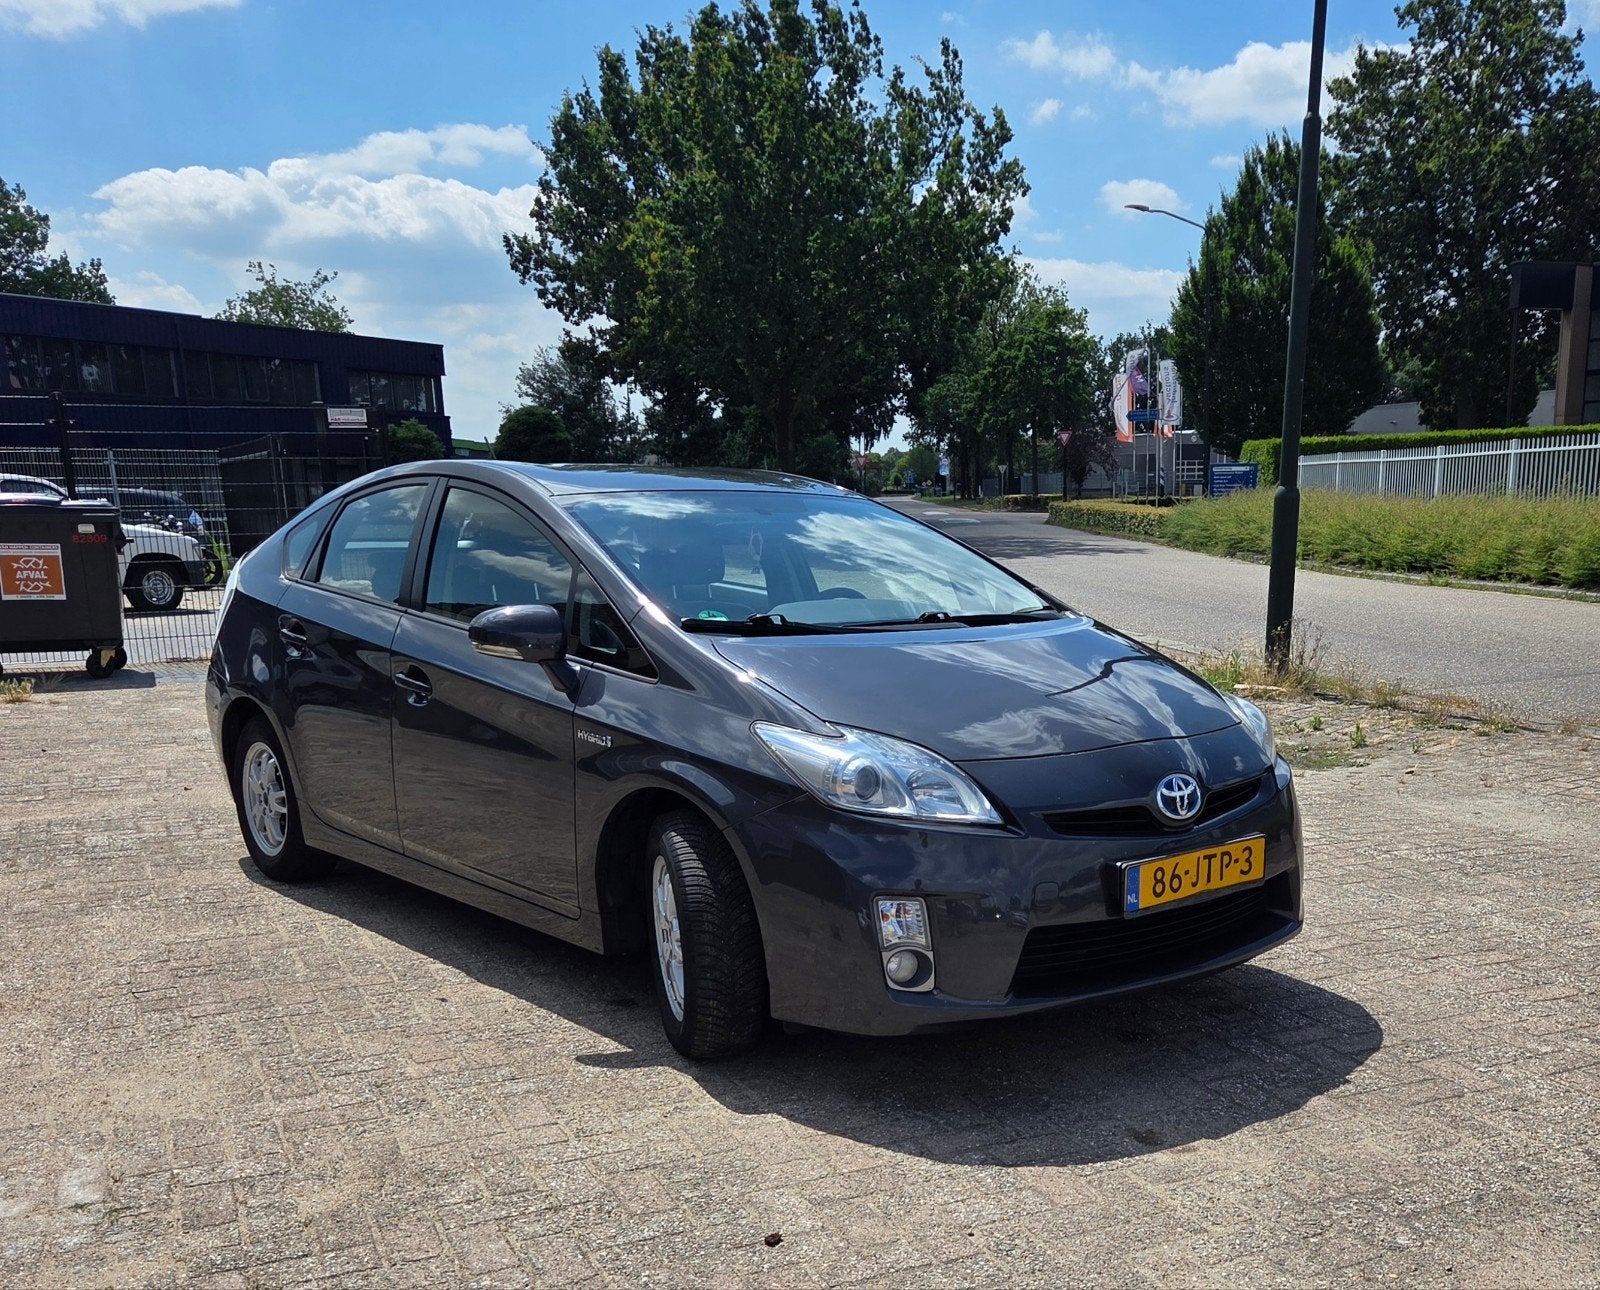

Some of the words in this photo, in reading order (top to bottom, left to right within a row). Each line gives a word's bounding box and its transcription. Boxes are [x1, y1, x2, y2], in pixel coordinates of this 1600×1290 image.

[72, 534, 107, 543] 82809
[16, 570, 48, 579] AFVAL
[1127, 892, 1138, 904] NL
[1152, 846, 1254, 898] 86-JTP-3
